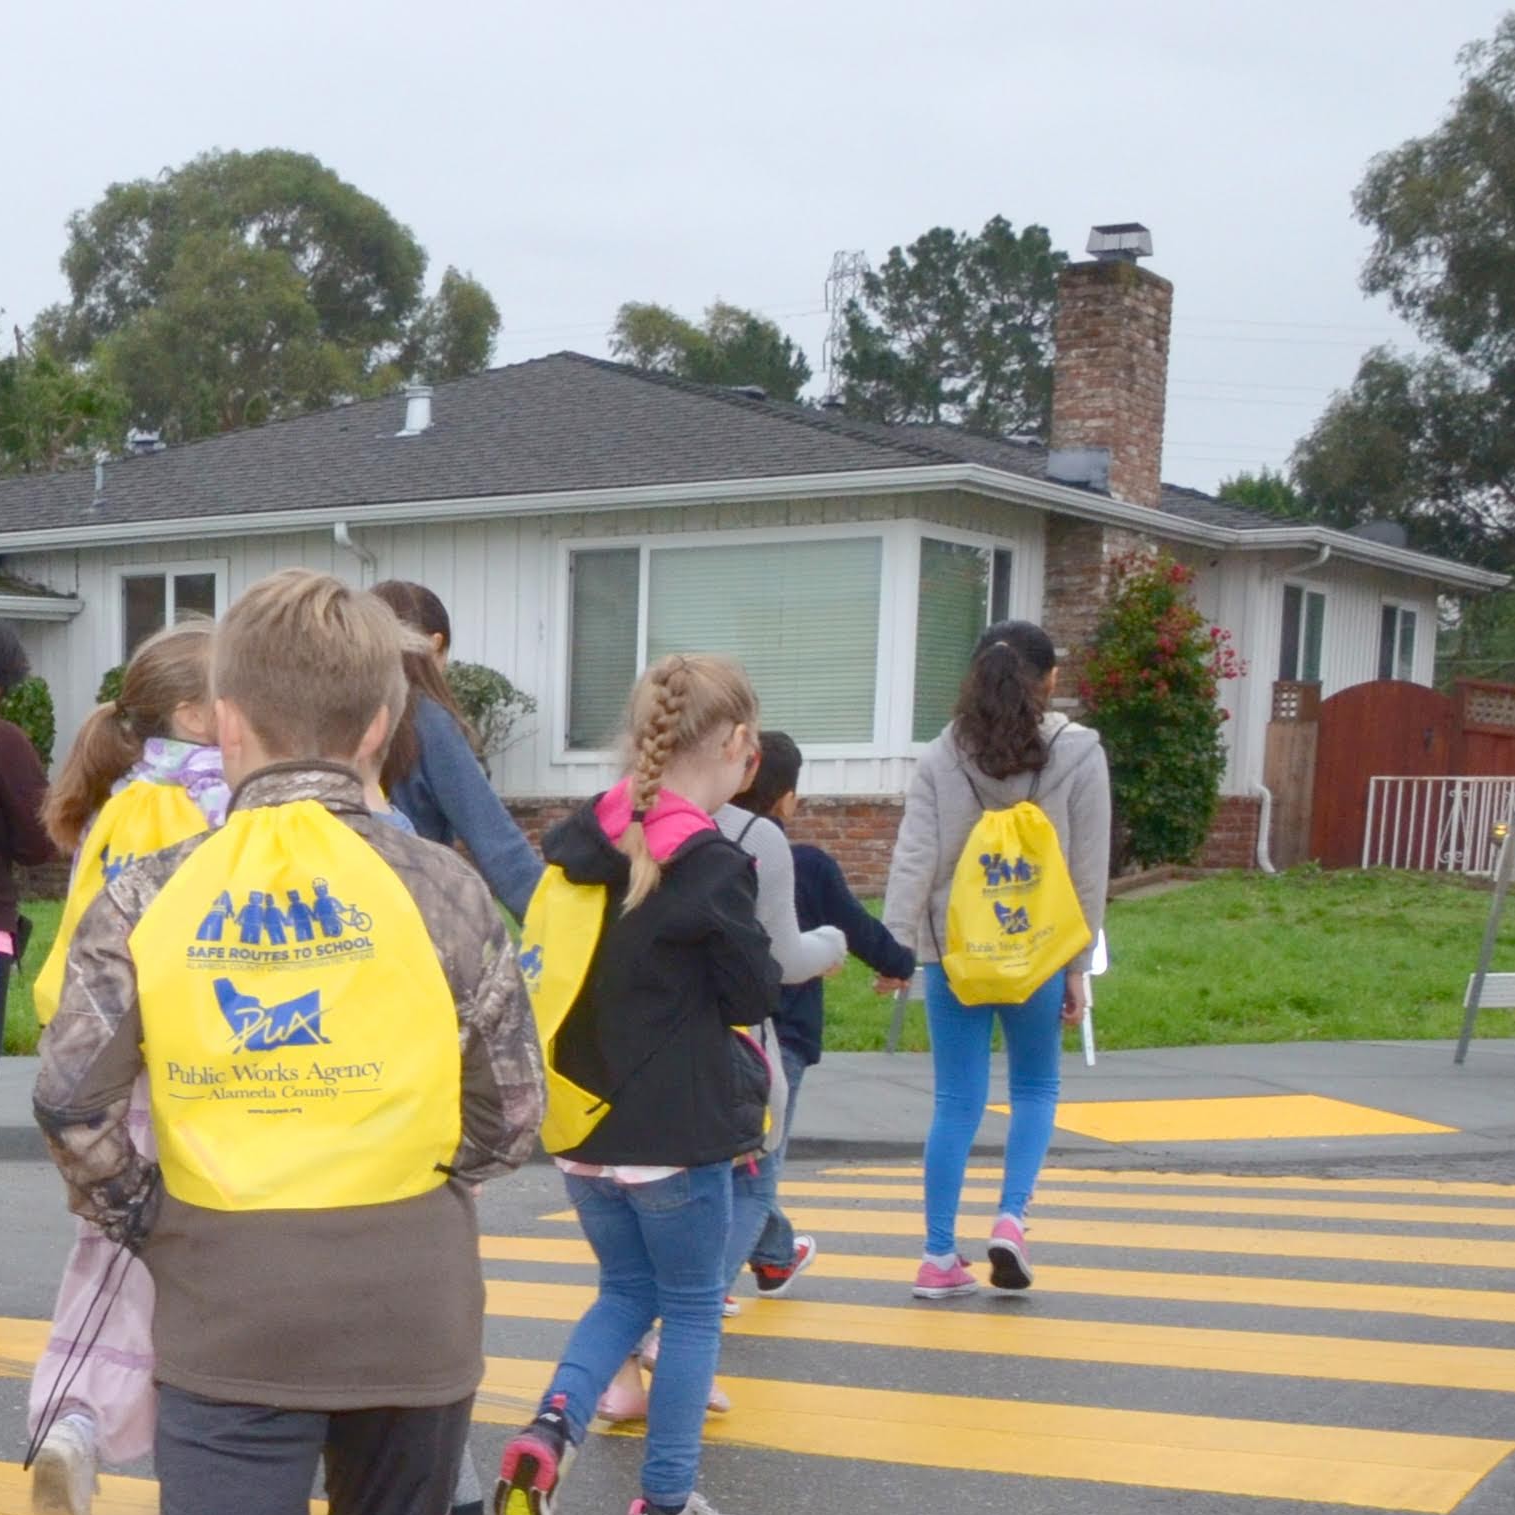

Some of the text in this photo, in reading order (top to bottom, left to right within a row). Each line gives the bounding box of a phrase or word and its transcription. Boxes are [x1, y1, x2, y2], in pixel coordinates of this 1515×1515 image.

[186, 936, 375, 962] SAFE ROUTES TO SCHOOL
[167, 1061, 384, 1086] Public Works Agency
[208, 1085, 340, 1101] Alameda County
